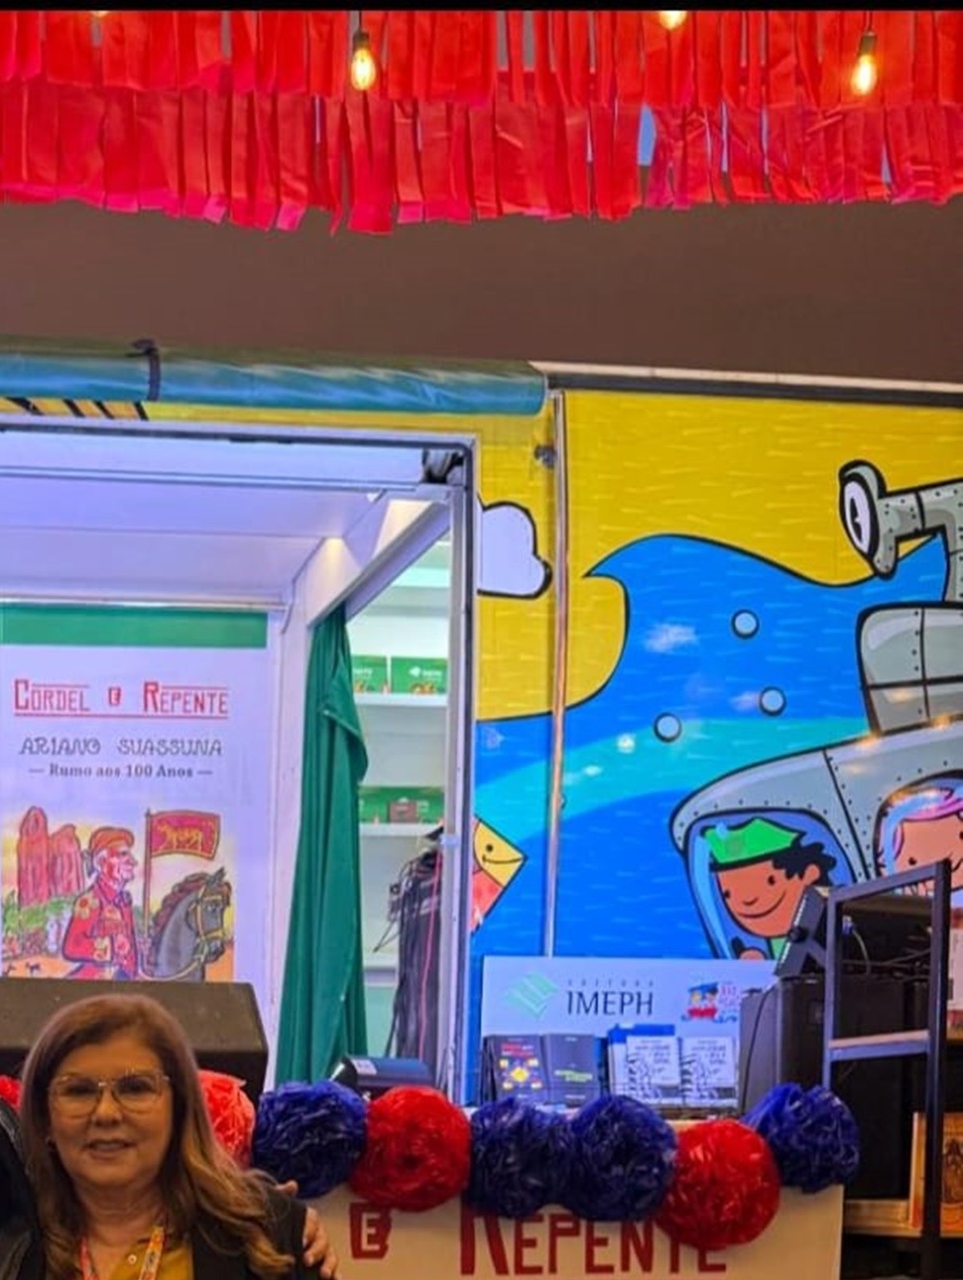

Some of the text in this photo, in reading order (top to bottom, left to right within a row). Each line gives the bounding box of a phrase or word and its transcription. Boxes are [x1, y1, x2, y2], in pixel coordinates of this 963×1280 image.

[13, 678, 91, 713] CORDEL
[143, 680, 229, 714] REPENTE
[19, 737, 223, 757] ARIANO SUASSUNA
[49, 763, 194, 779] Rumo aos 100 Anos
[566, 990, 654, 1016] IMEPH
